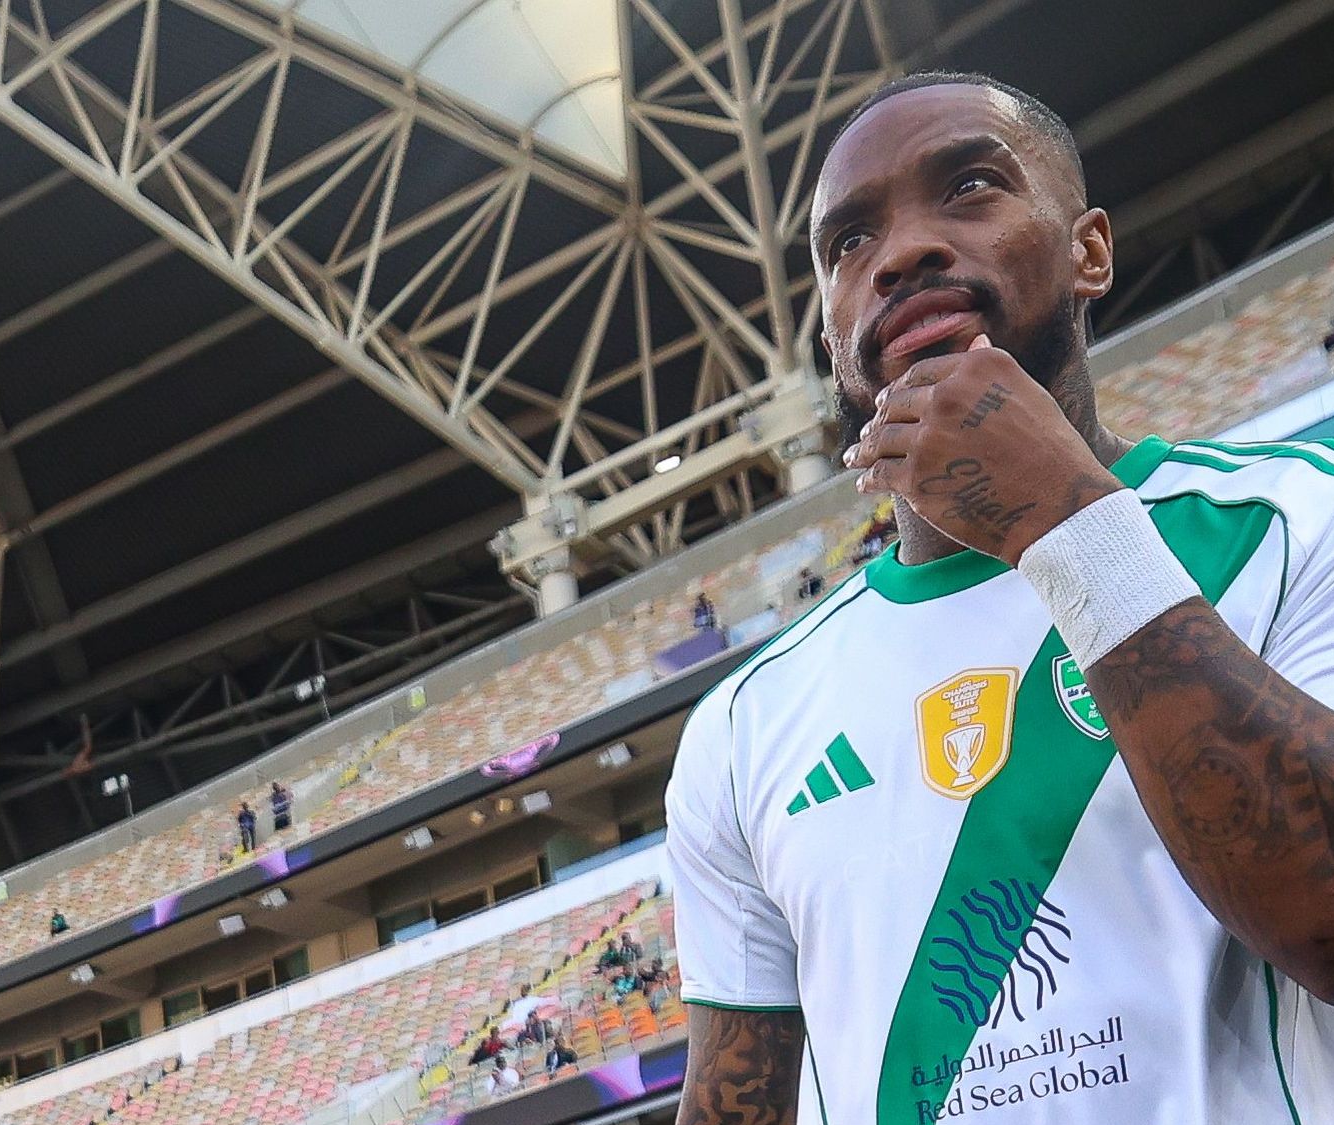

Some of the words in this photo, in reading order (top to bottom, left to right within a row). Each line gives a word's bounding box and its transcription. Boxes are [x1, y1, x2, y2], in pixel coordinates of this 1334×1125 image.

[916, 1088, 965, 1125] Red
[970, 1082, 1024, 1112] Sea
[1029, 1053, 1130, 1099] Global
